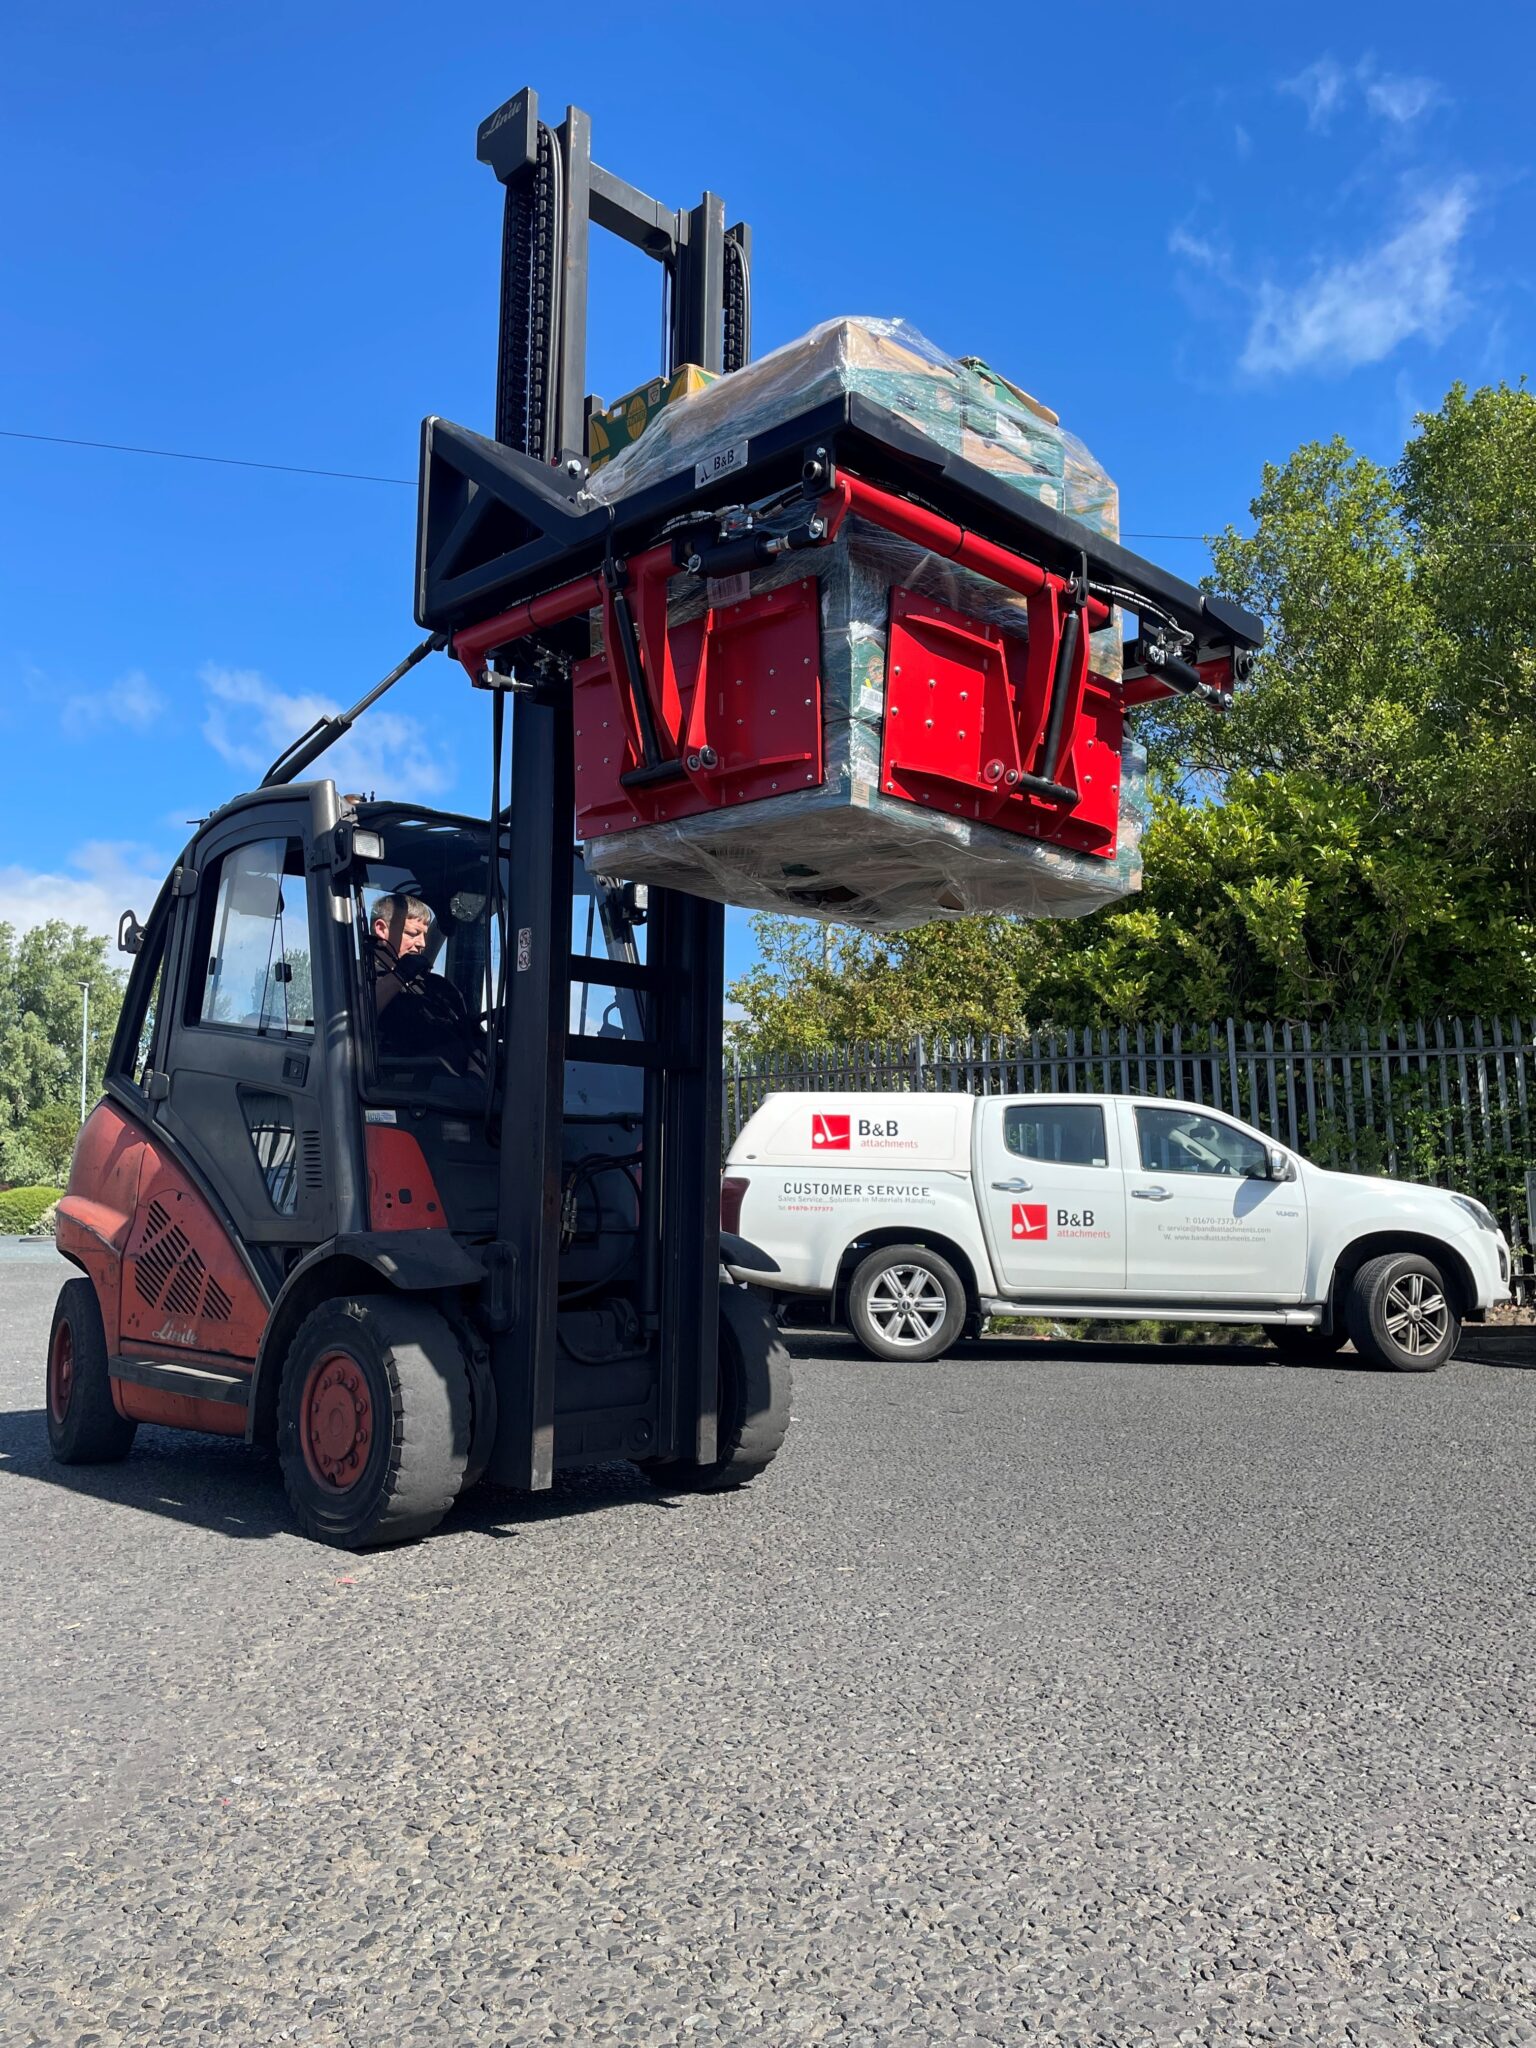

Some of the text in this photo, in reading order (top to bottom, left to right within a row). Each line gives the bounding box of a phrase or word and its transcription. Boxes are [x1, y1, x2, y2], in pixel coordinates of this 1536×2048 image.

[714, 450, 734, 470] B&B
[859, 1120, 899, 1137] B&B
[860, 1138, 919, 1149] attachments
[784, 1182, 930, 1197] CUSTOMER SERVICE
[1057, 1209, 1095, 1227] B&B
[1057, 1229, 1111, 1239] attachments
